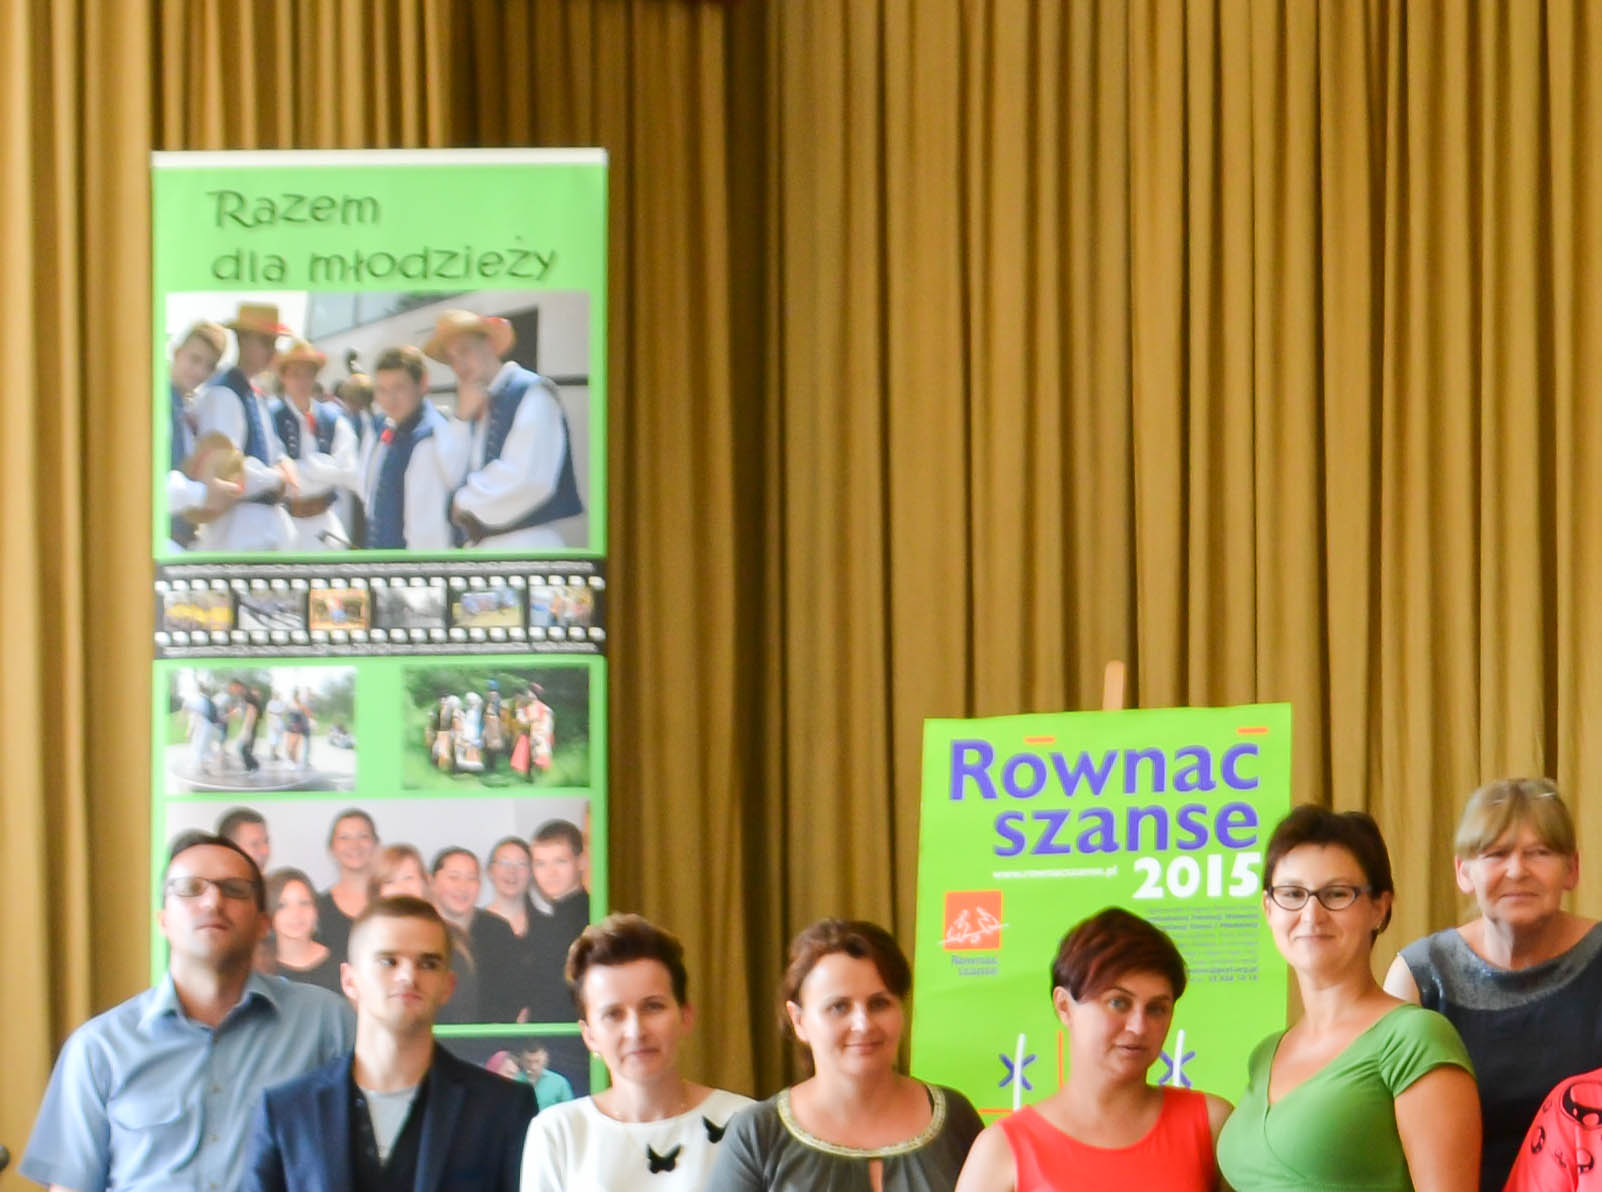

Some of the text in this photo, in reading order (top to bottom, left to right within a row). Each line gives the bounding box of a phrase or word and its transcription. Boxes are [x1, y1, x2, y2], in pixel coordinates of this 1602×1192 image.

[206, 190, 380, 229] Razem
[211, 235, 557, 283] dla młodzieży
[992, 801, 1259, 857] szanse
[1132, 852, 1262, 899] 2015
